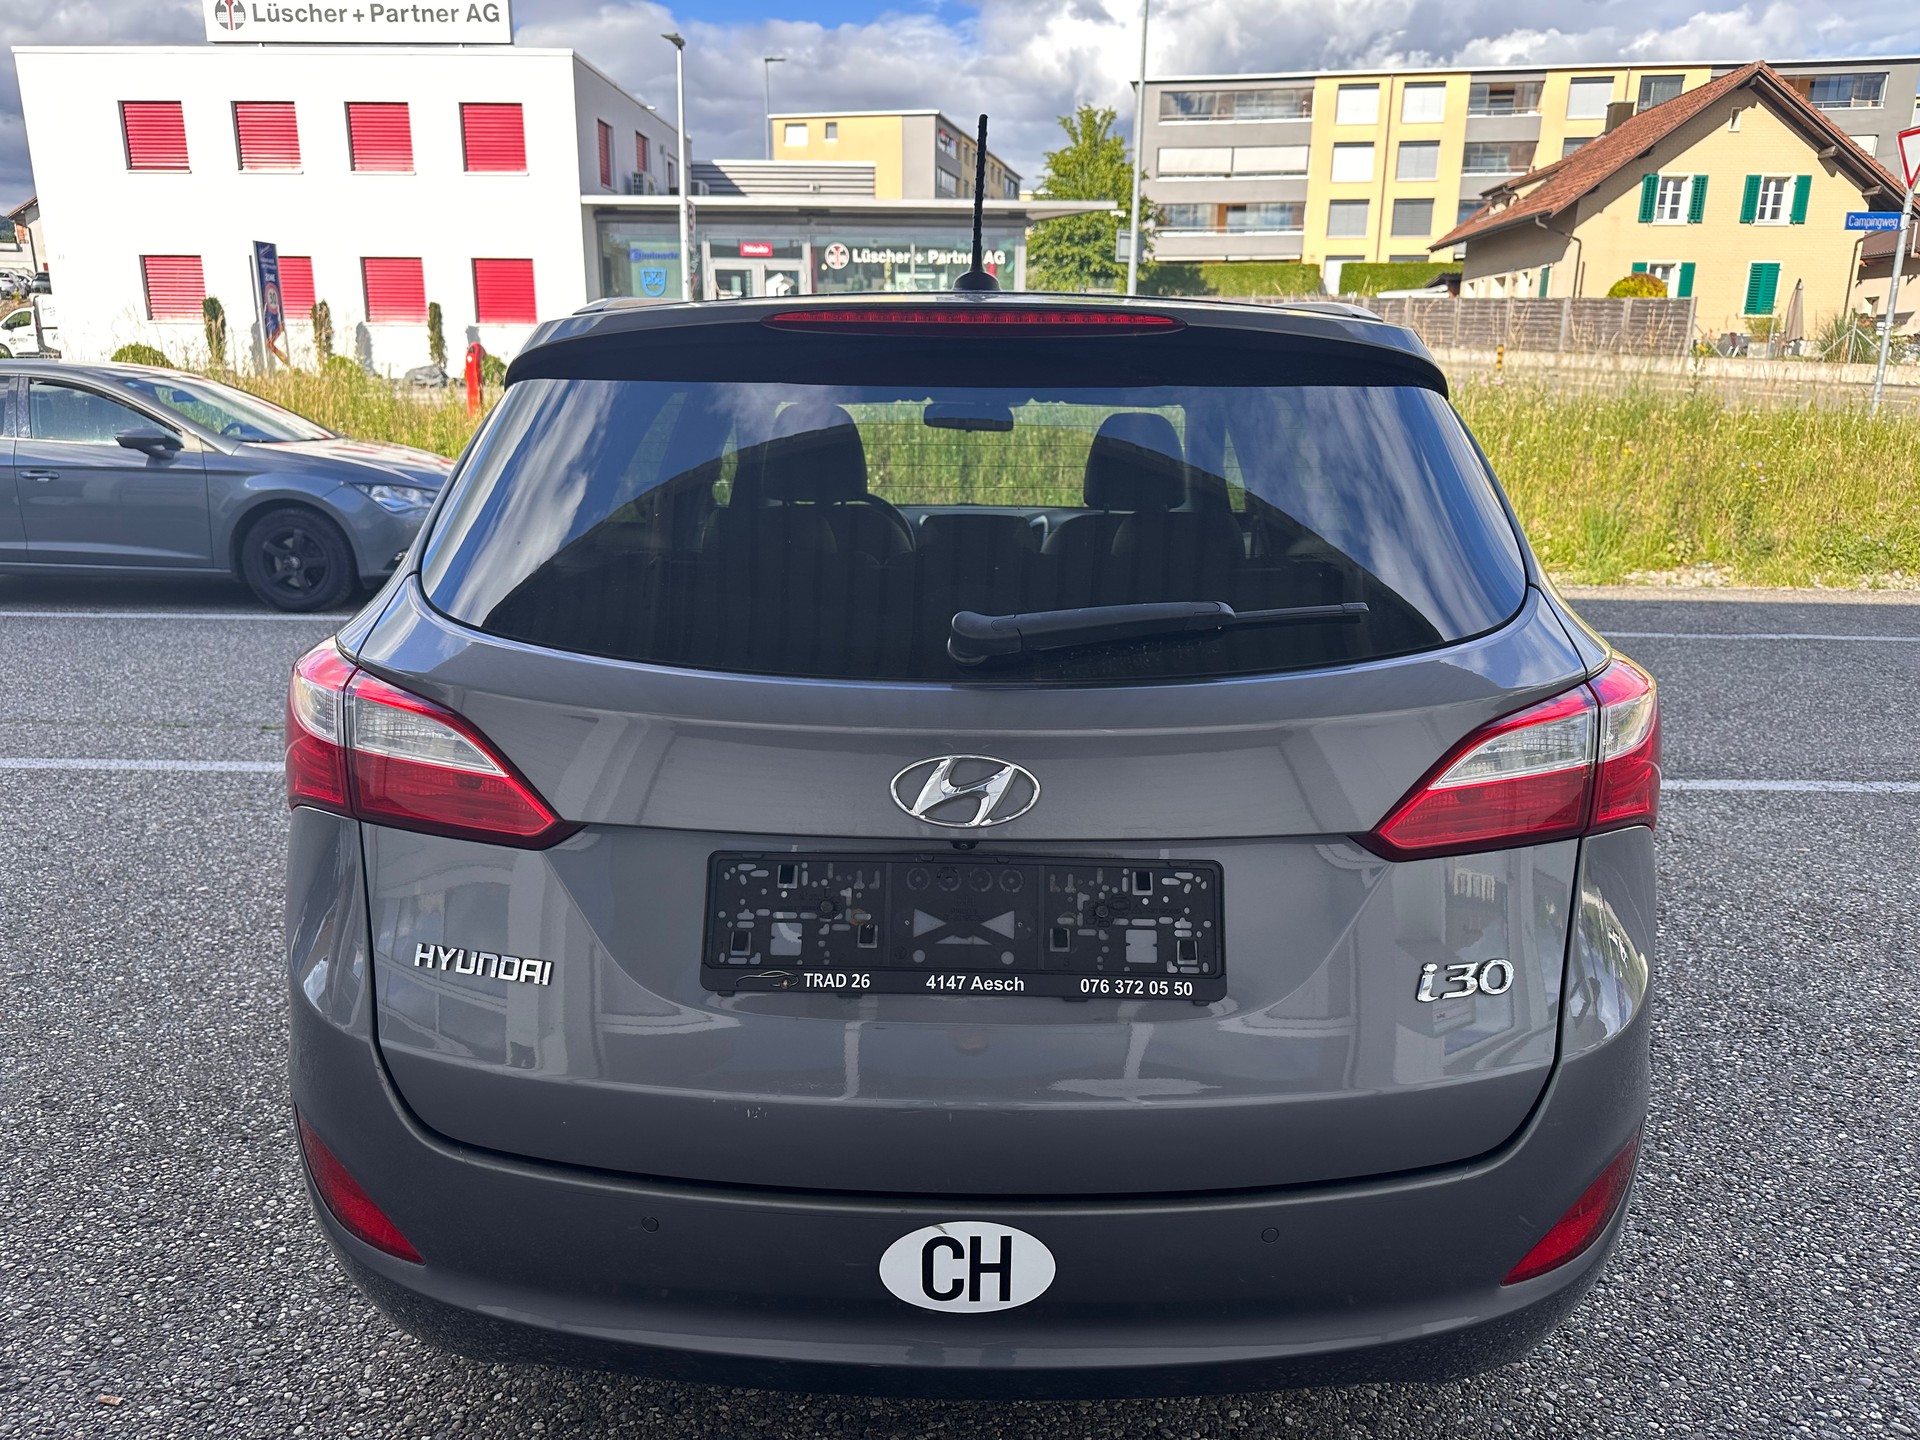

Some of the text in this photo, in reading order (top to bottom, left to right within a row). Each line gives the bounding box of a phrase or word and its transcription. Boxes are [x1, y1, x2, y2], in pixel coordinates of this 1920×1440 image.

[252, 3, 500, 23] Lüscher + Partner AG
[1848, 215, 1898, 229] Campingweg
[852, 248, 911, 264] Lüscher
[927, 249, 973, 265] Partne
[983, 250, 1006, 265] AG
[414, 942, 552, 985] HYUNDAI
[804, 973, 871, 988] TRAD 26
[926, 975, 1025, 992] 4147 Aesch
[1080, 978, 1193, 996] 076 372 05 50
[1417, 959, 1514, 1002] i30
[921, 1235, 1012, 1302] CH
